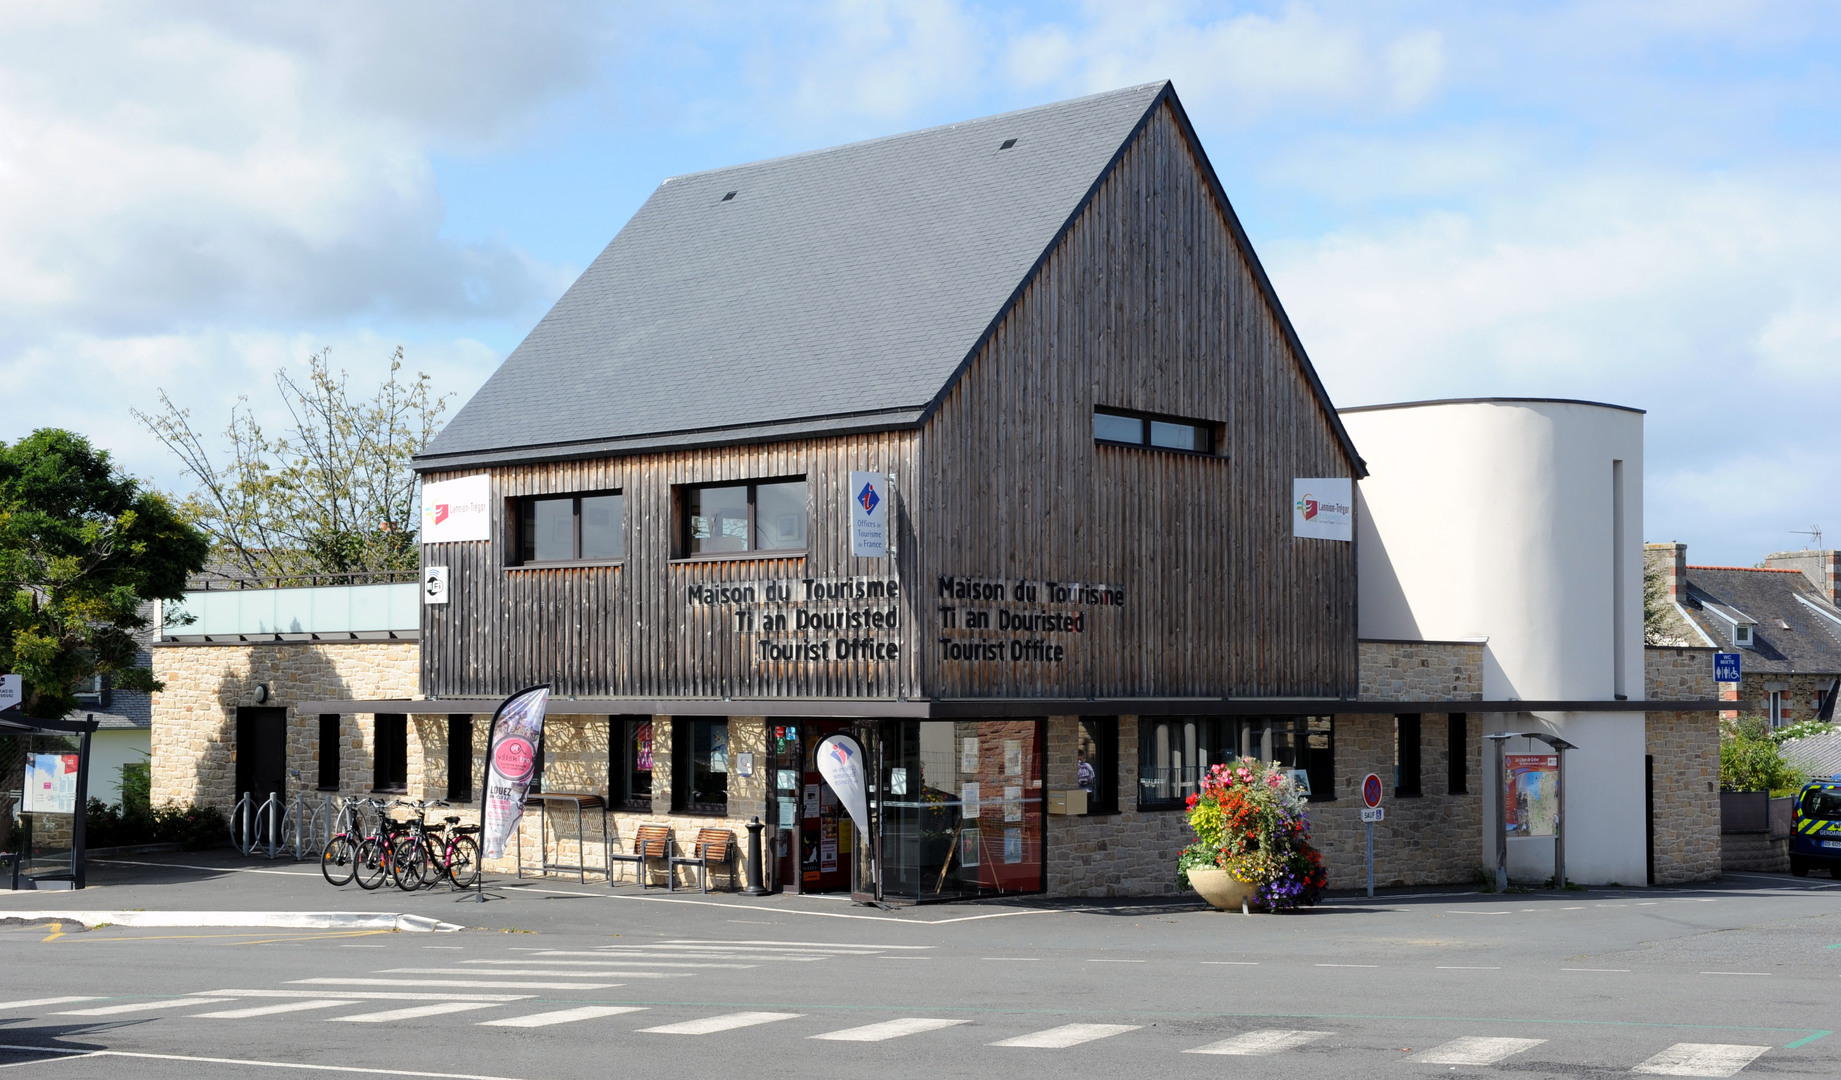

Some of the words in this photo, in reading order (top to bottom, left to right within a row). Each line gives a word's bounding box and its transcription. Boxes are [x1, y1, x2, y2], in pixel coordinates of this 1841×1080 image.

[857, 519, 875, 527] Offices
[857, 530, 882, 538] Tourisme
[863, 540, 882, 548] France
[688, 584, 755, 605] Maison
[766, 580, 790, 601] du
[802, 577, 898, 600] Tourisme
[939, 577, 1004, 600] Maison
[1015, 580, 1036, 602] du
[1047, 582, 1124, 606] Tourisme
[735, 610, 753, 632] Ti
[763, 613, 786, 631] an
[796, 606, 897, 630] Douristed
[940, 606, 956, 629] Ti
[966, 611, 988, 629] an
[999, 609, 1085, 632] Douristed
[759, 639, 829, 660] Tourist
[835, 638, 898, 660] Office
[940, 638, 1005, 660] Tourist
[1010, 639, 1063, 662] Office
[490, 785, 511, 797] LOUEZ
[1364, 811, 1375, 819] SAUF
